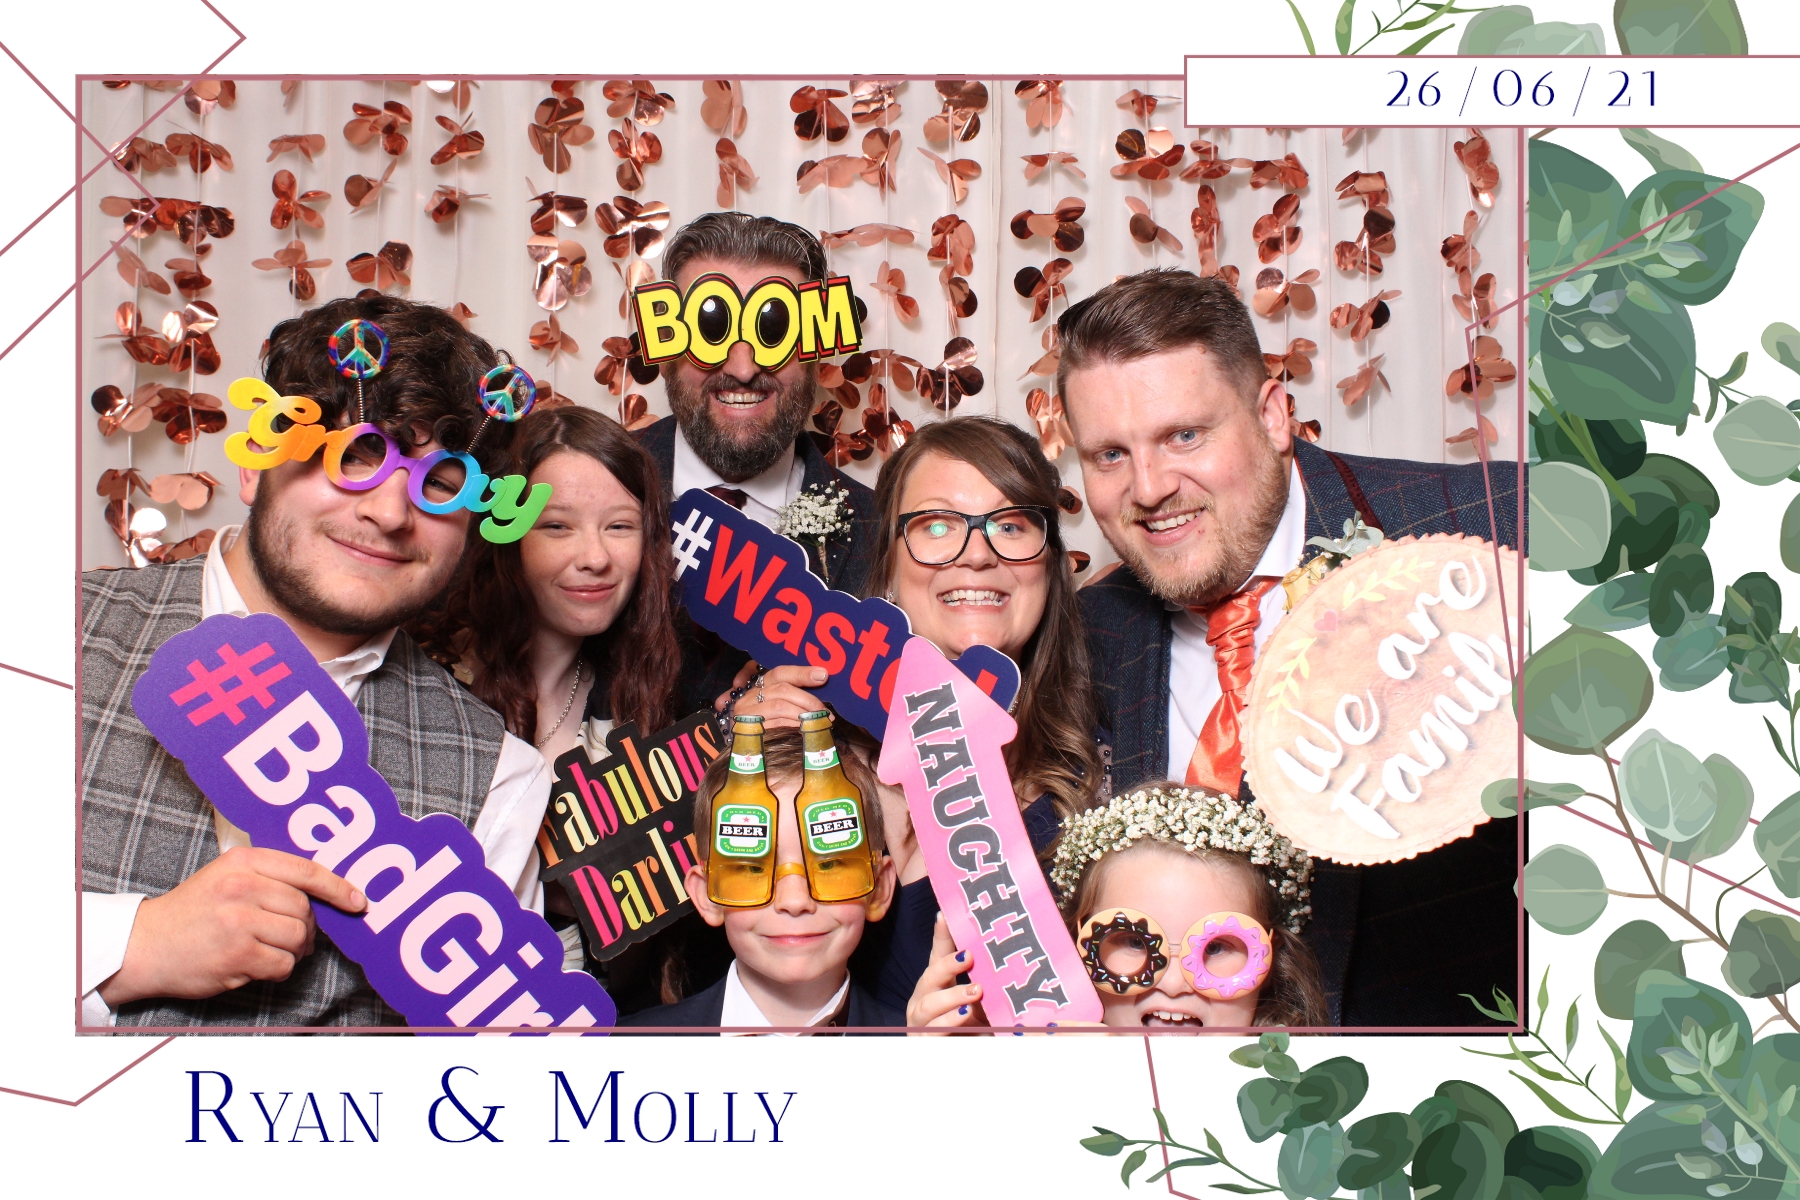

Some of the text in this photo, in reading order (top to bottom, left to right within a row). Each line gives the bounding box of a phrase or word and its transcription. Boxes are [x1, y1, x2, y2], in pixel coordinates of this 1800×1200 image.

[632, 272, 862, 371] BOOM
[671, 508, 998, 716] #Wast
[1274, 556, 1487, 793] We are
[568, 820, 703, 948] Darli
[722, 825, 764, 836] BEER
[812, 819, 854, 834] BEER
[904, 681, 1070, 1017] NAUGHTY
